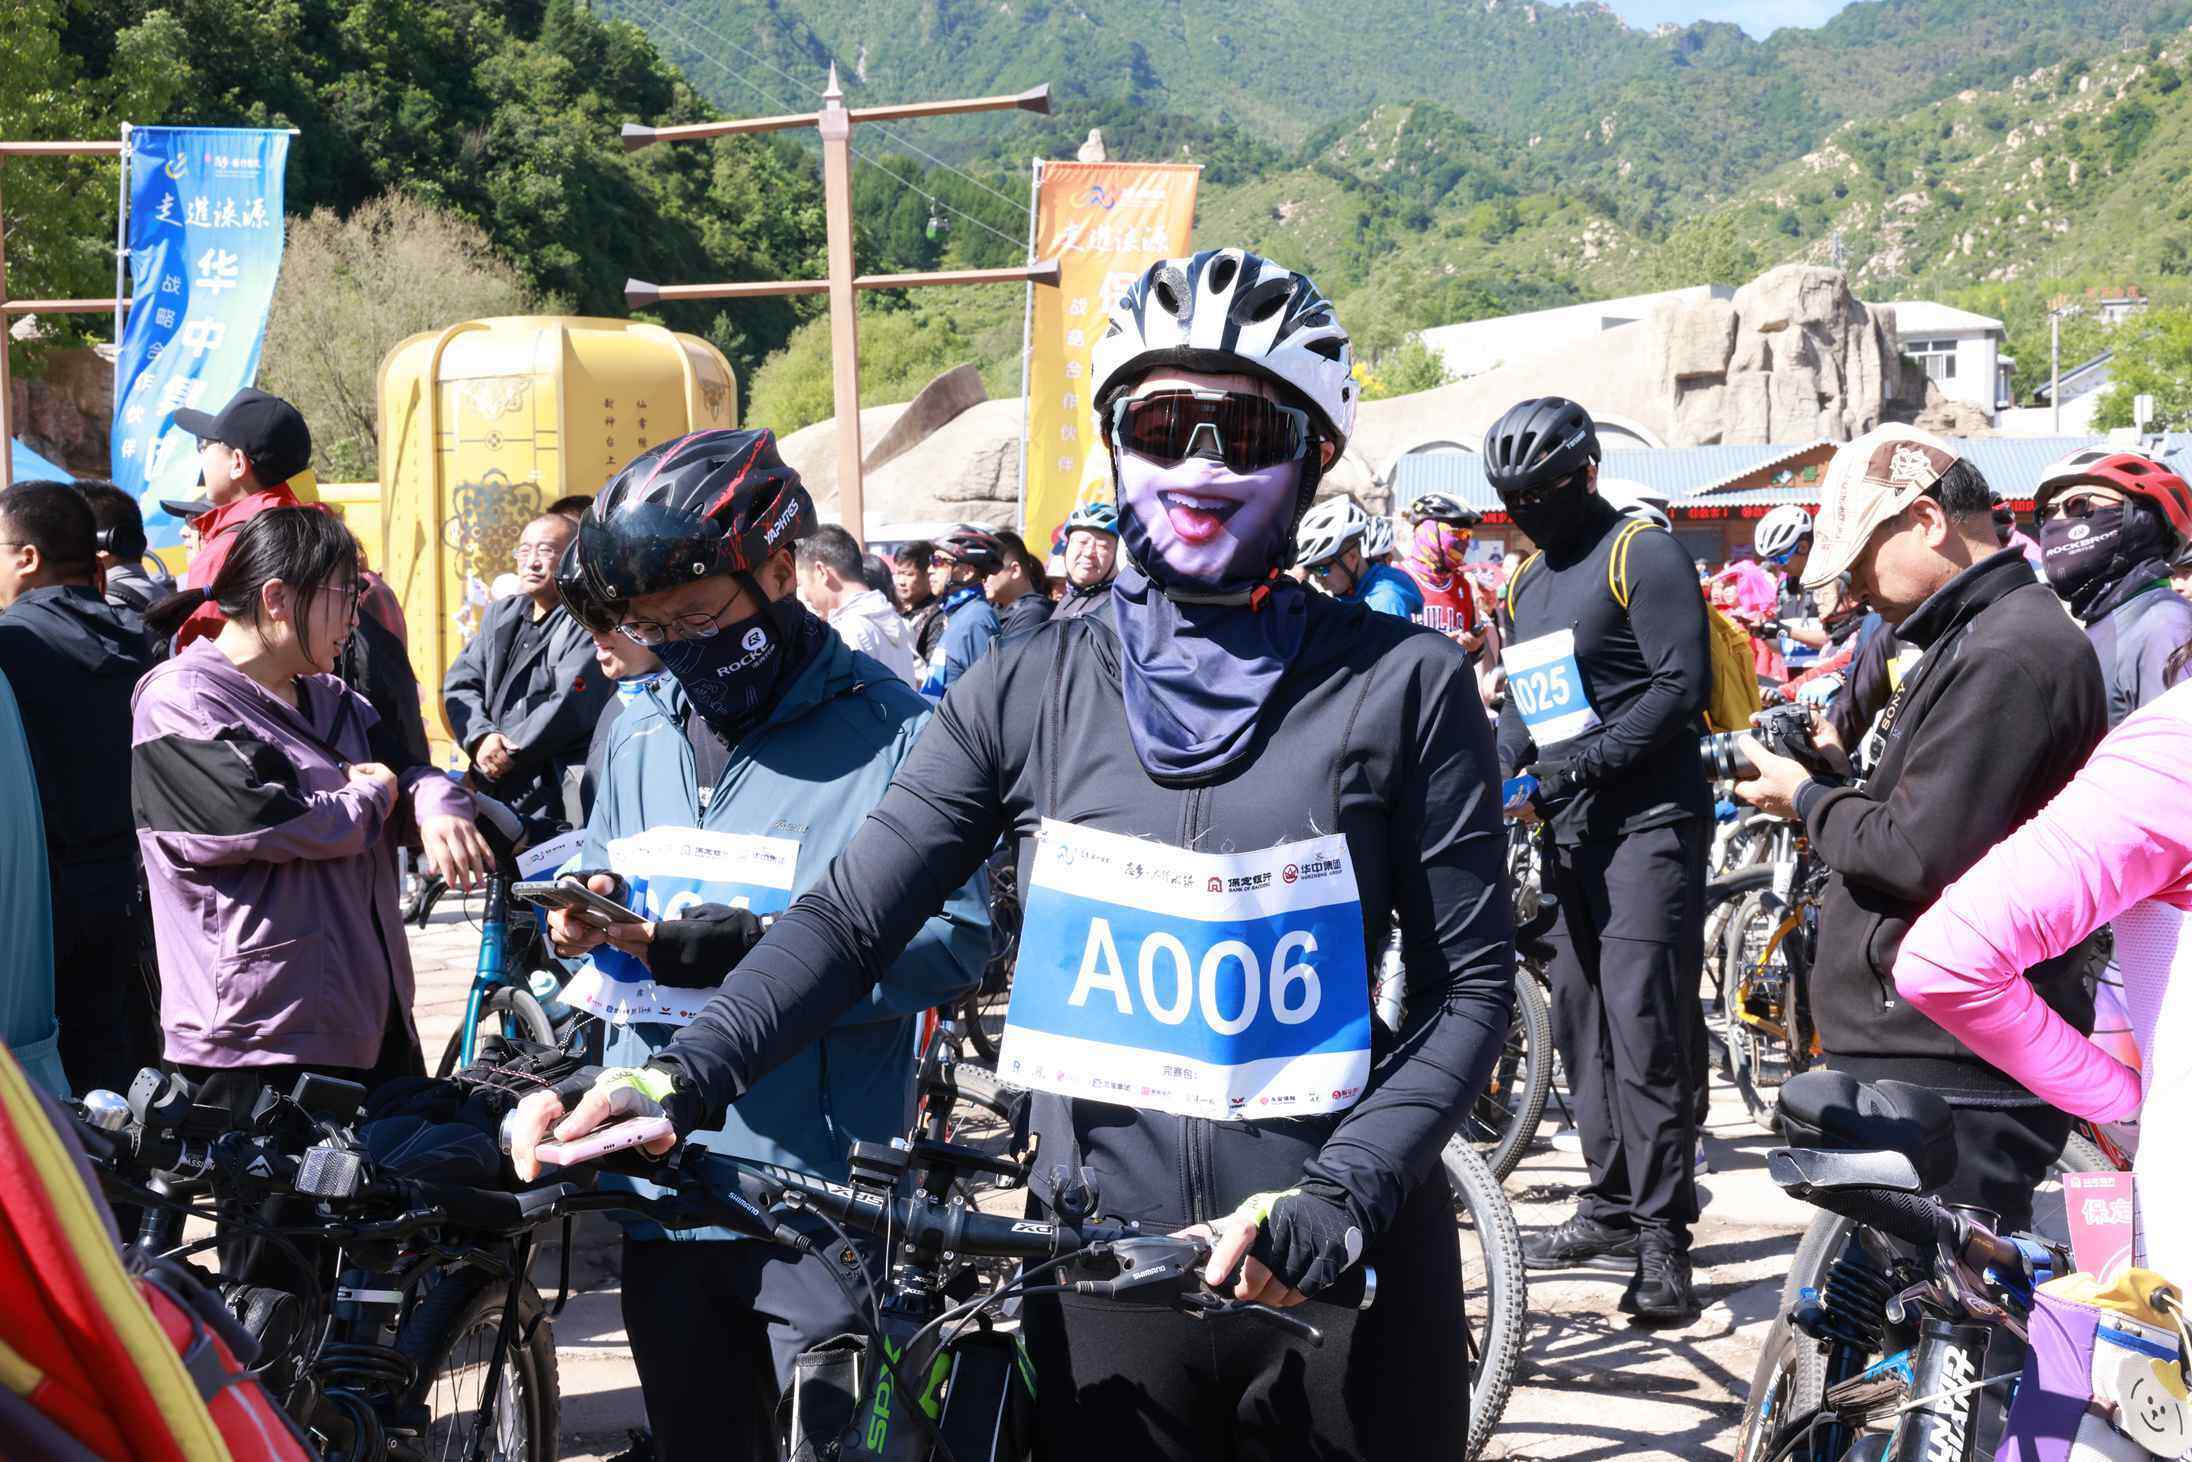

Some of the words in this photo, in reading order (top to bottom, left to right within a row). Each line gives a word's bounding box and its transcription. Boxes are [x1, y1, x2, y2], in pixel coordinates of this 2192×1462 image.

[1881, 681, 1906, 731] SONY
[1301, 858, 1342, 875] 华中集团
[1067, 916, 1322, 1036] A006
[727, 1191, 760, 1217] SHIMANO
[1132, 1264, 1166, 1281] SHIMANO
